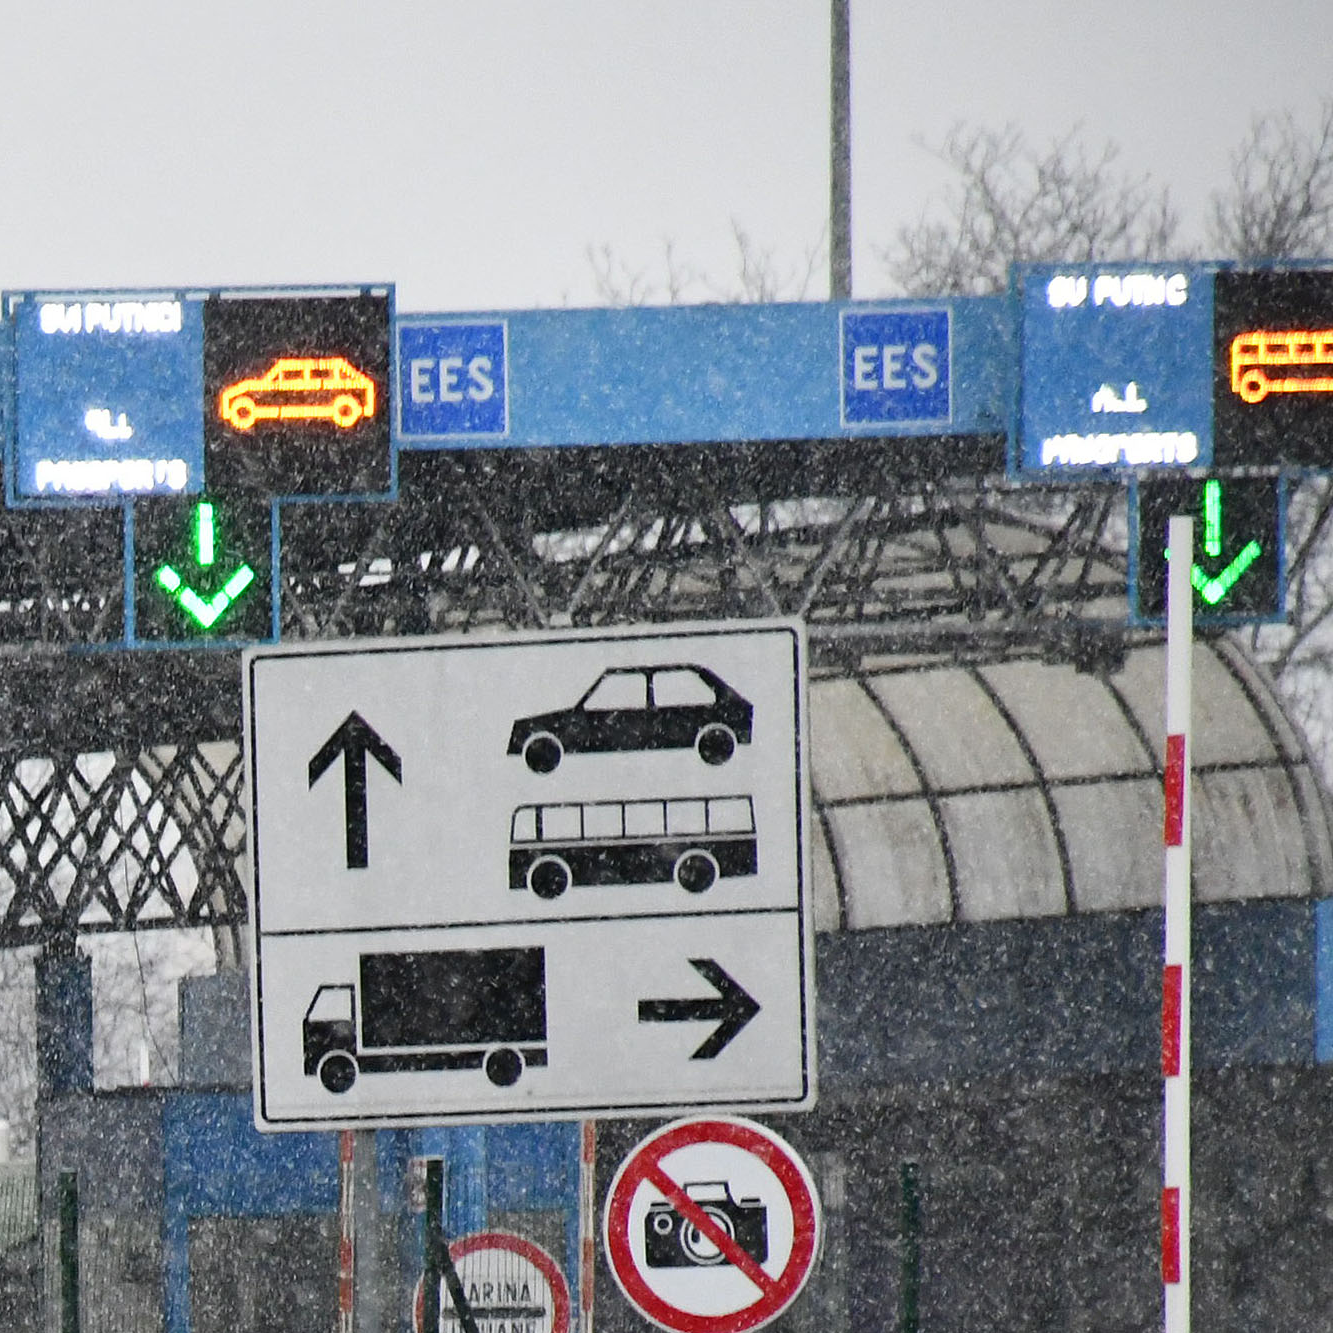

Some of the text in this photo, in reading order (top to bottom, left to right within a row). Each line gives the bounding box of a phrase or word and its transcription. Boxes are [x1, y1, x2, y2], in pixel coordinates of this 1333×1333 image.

[411, 356, 493, 403] EES
[854, 343, 937, 390] EES
[469, 1280, 532, 1303] ARINA
